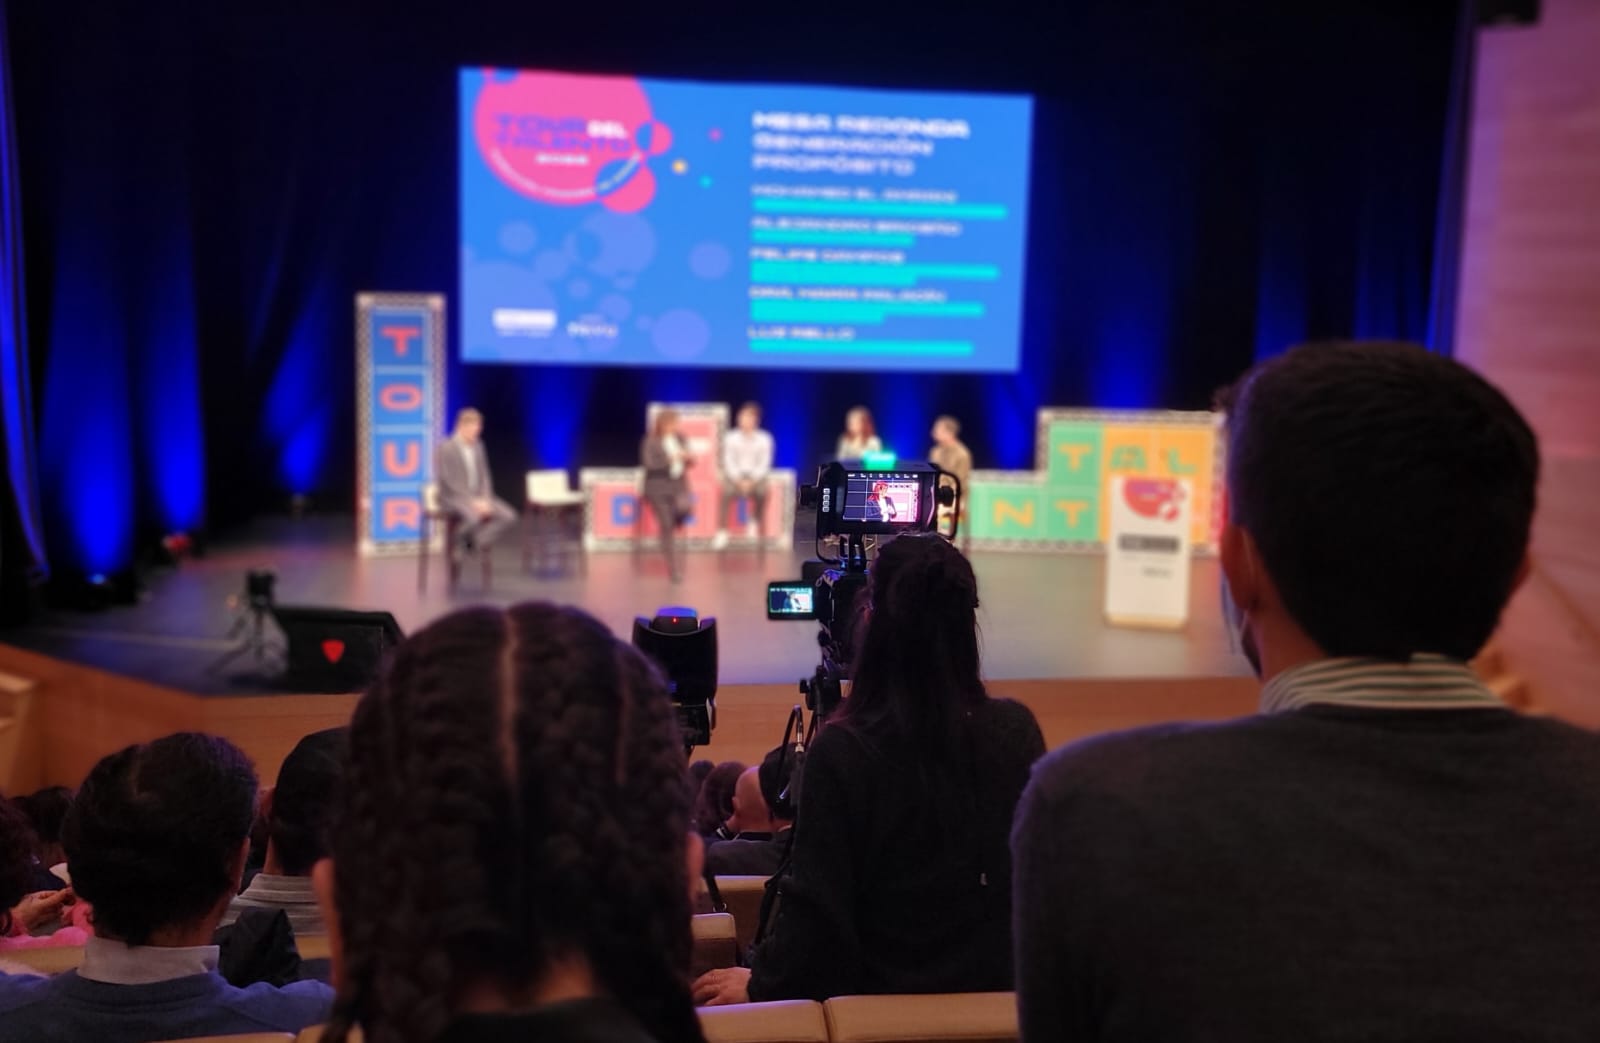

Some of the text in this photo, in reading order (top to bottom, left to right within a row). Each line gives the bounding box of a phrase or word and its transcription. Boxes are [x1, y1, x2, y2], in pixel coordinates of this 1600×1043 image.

[587, 119, 629, 140] DEL
[752, 111, 970, 139] MESA REDONDA
[379, 325, 423, 532] TOUR
[1057, 442, 1198, 475] TAL
